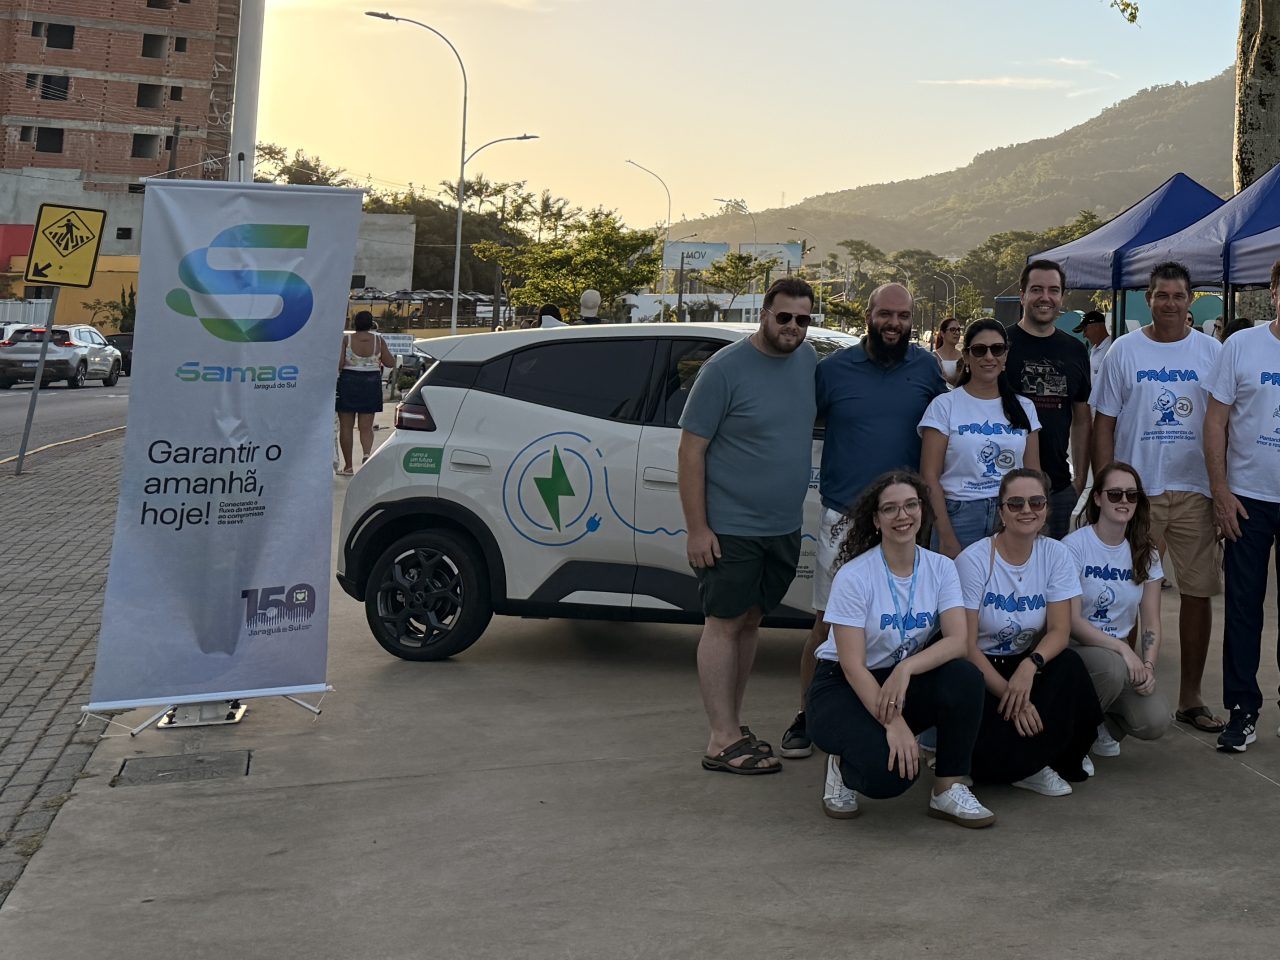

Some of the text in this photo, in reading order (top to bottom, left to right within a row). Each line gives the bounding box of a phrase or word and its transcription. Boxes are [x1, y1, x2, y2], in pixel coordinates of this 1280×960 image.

[175, 362, 299, 382] Samae
[1136, 366, 1199, 382] PROEVA
[254, 382, 276, 390] Jaraguá
[1178, 402, 1189, 412] 20
[148, 440, 282, 464] Garantir o
[144, 469, 264, 497] amanhã,
[140, 501, 211, 531] hoje!
[241, 583, 316, 629] 150
[984, 590, 1046, 612] PROEVA
[248, 627, 281, 636] Jaraguá
